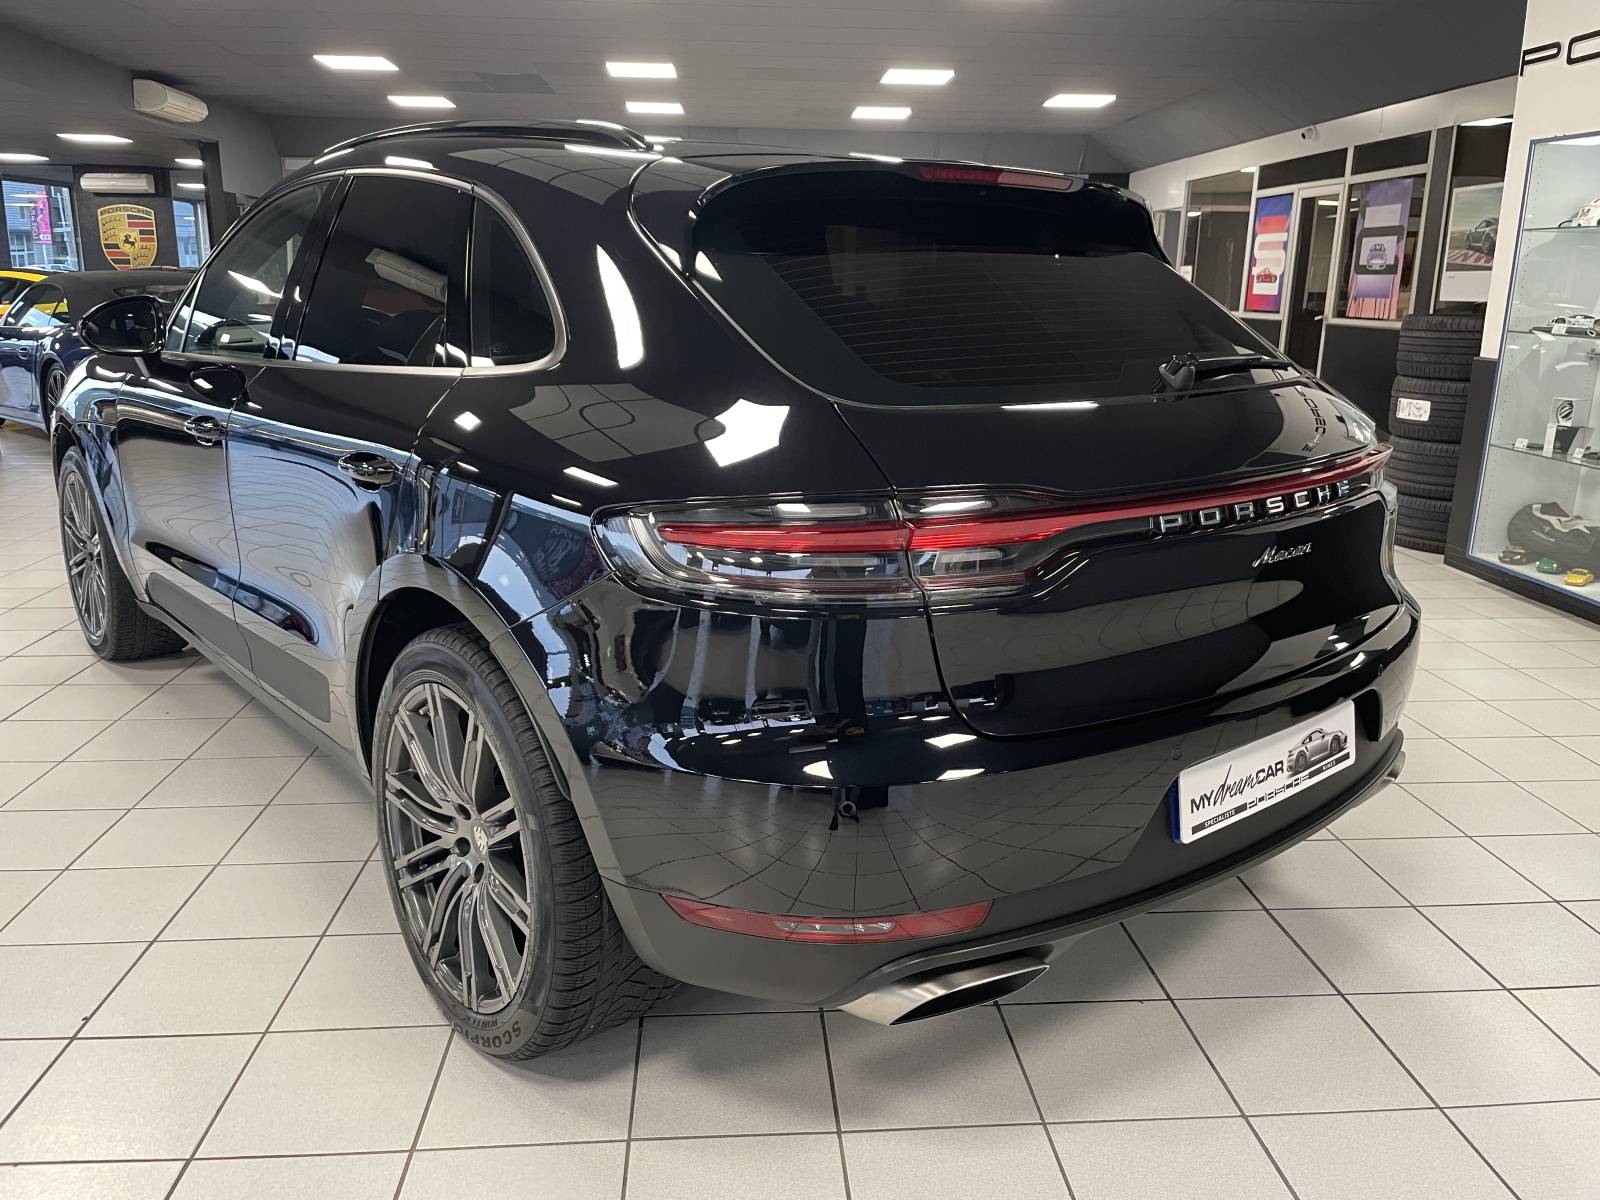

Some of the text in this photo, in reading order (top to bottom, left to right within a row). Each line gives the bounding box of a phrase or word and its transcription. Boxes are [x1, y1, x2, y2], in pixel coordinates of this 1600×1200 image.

[99, 206, 152, 216] PORSCHE
[1160, 480, 1350, 533] PORSCHE
[1252, 542, 1312, 568] Macan
[1204, 809, 1236, 828] SPECIALISTE
